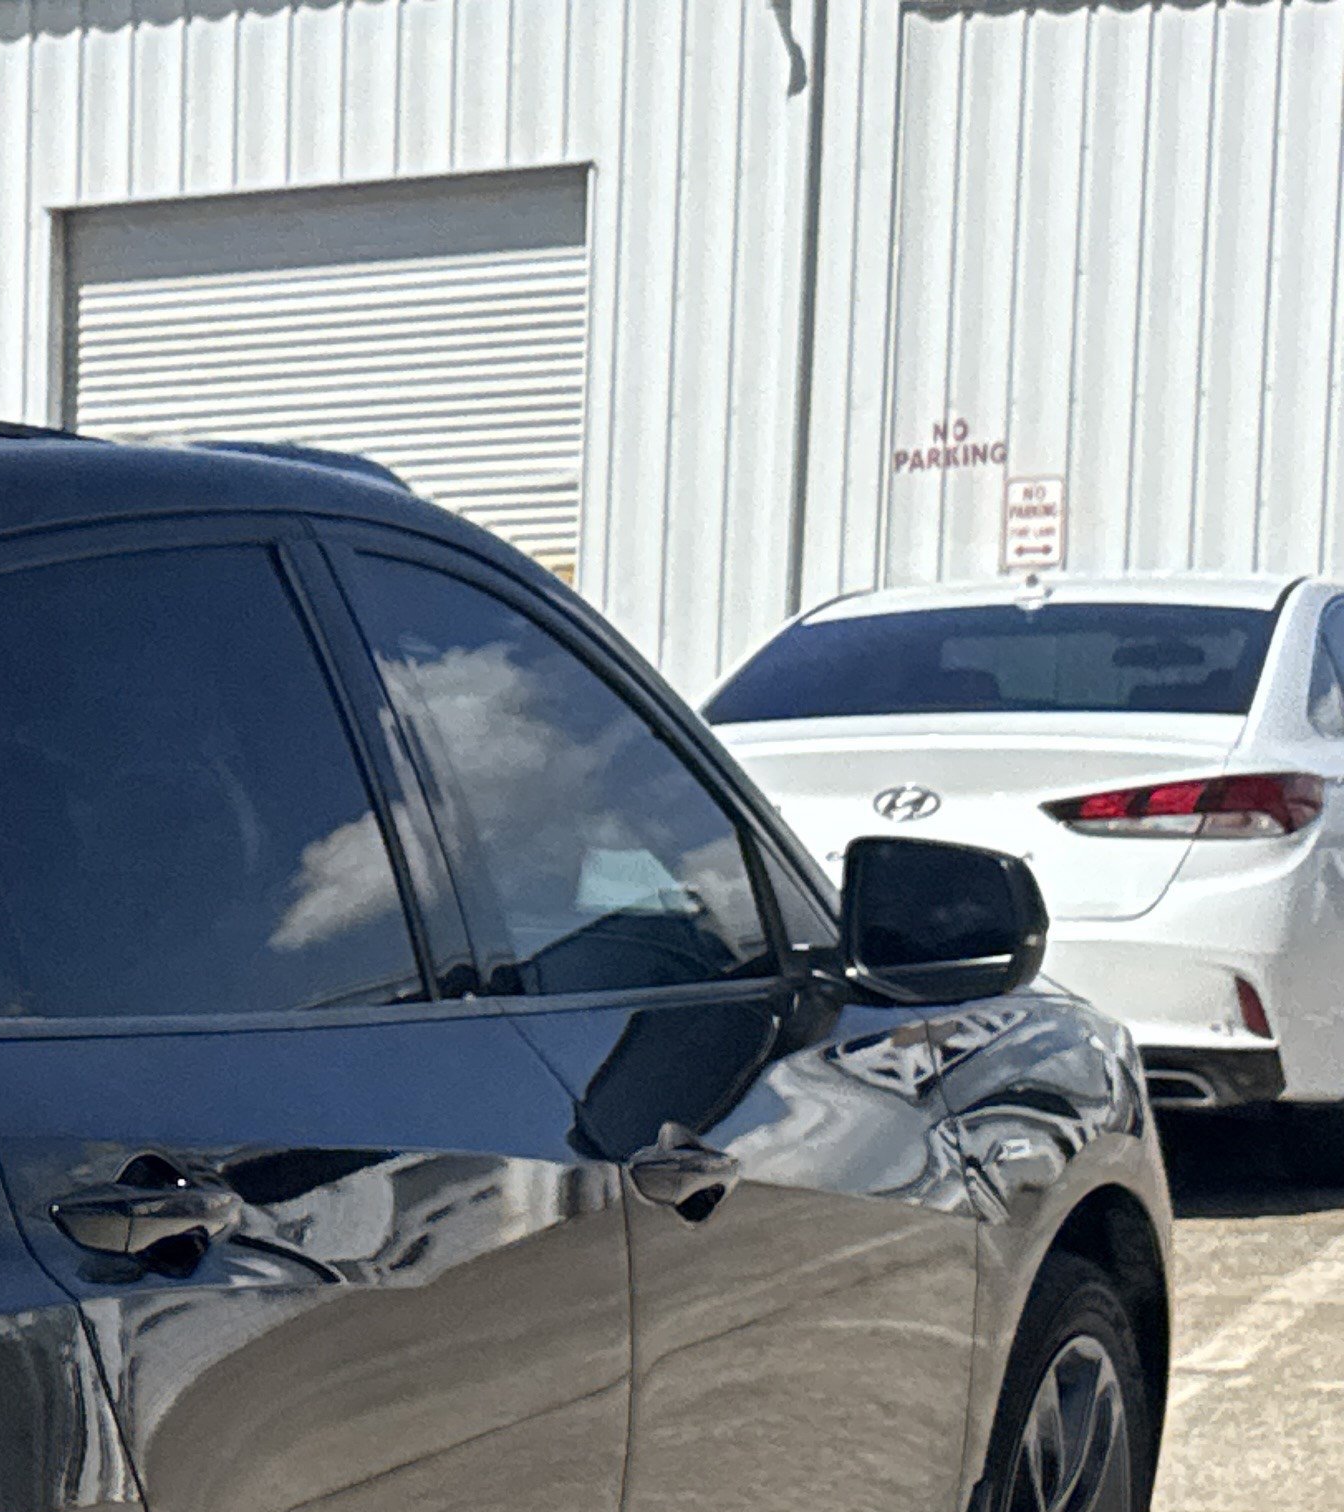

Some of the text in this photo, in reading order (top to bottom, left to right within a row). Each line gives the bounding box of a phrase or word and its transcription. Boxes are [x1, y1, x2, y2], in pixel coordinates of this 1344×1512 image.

[933, 417, 969, 443] NO
[893, 441, 1009, 474] PARKING
[1022, 485, 1047, 501] NO
